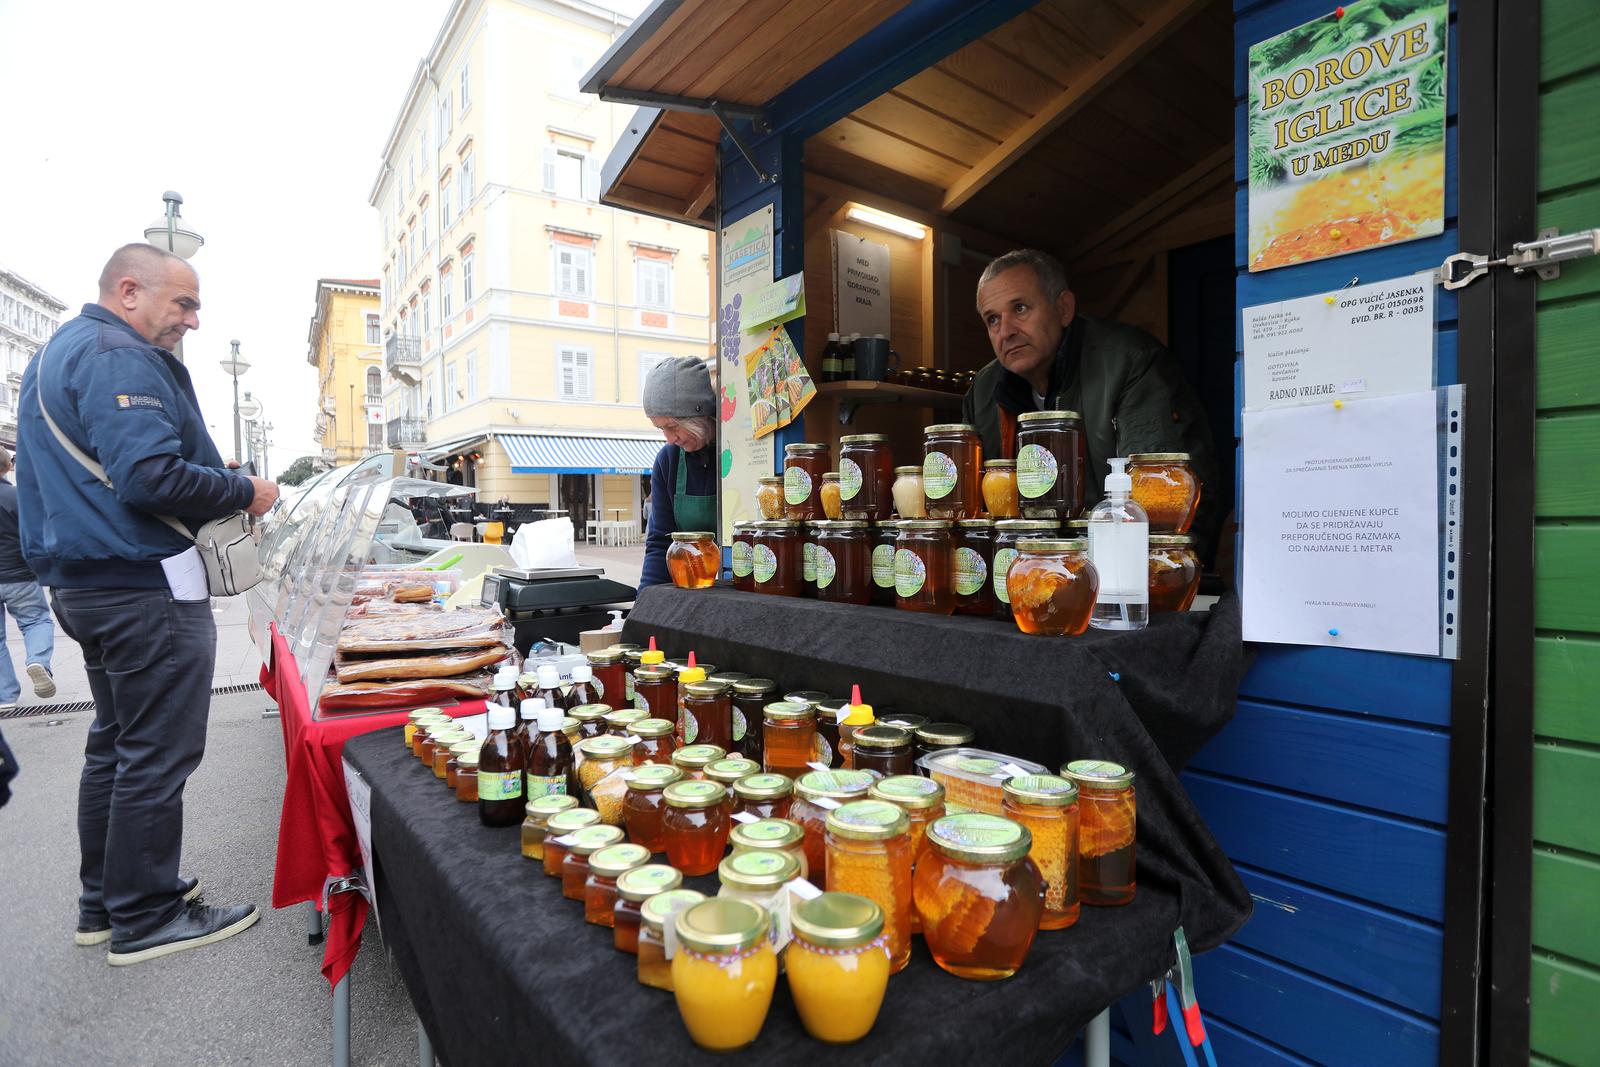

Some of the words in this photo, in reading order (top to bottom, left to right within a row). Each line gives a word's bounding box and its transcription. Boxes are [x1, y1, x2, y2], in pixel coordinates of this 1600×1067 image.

[1261, 22, 1429, 111] BOROVE
[1273, 78, 1412, 150] IGLICE
[1291, 155, 1310, 177] U
[1312, 131, 1390, 172] MEDU
[856, 257, 870, 267] MED
[847, 267, 879, 283] PRIMORSKO
[847, 280, 881, 296] GORANSKOG
[855, 296, 872, 306] KRAJA
[1340, 298, 1357, 308] OPG
[1385, 286, 1424, 300] JASENKA
[1368, 303, 1385, 312] OPG
[1387, 296, 1424, 309] 0150698
[1351, 314, 1371, 325] EVID.
[1374, 312, 1386, 321] BR.
[1402, 305, 1424, 316] 0035
[1267, 361, 1299, 370] GOTOVINA
[1269, 387, 1297, 400] RADNO
[1299, 383, 1336, 397] VRIJEME:
[1281, 510, 1320, 518] MOLIMO
[1321, 508, 1367, 518] CIJENJENE
[1368, 507, 1399, 516] KUPCE
[1296, 521, 1309, 529] DA
[1310, 521, 1320, 529] SE
[1322, 519, 1384, 529] PRIDRŽAVAJU
[1281, 532, 1353, 541] PREPORUČENOG
[1355, 532, 1401, 540] RAZMAKA
[1288, 544, 1301, 552] OD
[1303, 544, 1350, 552] NAJMANJE
[1353, 544, 1357, 552] 1
[1360, 544, 1393, 552] METAR
